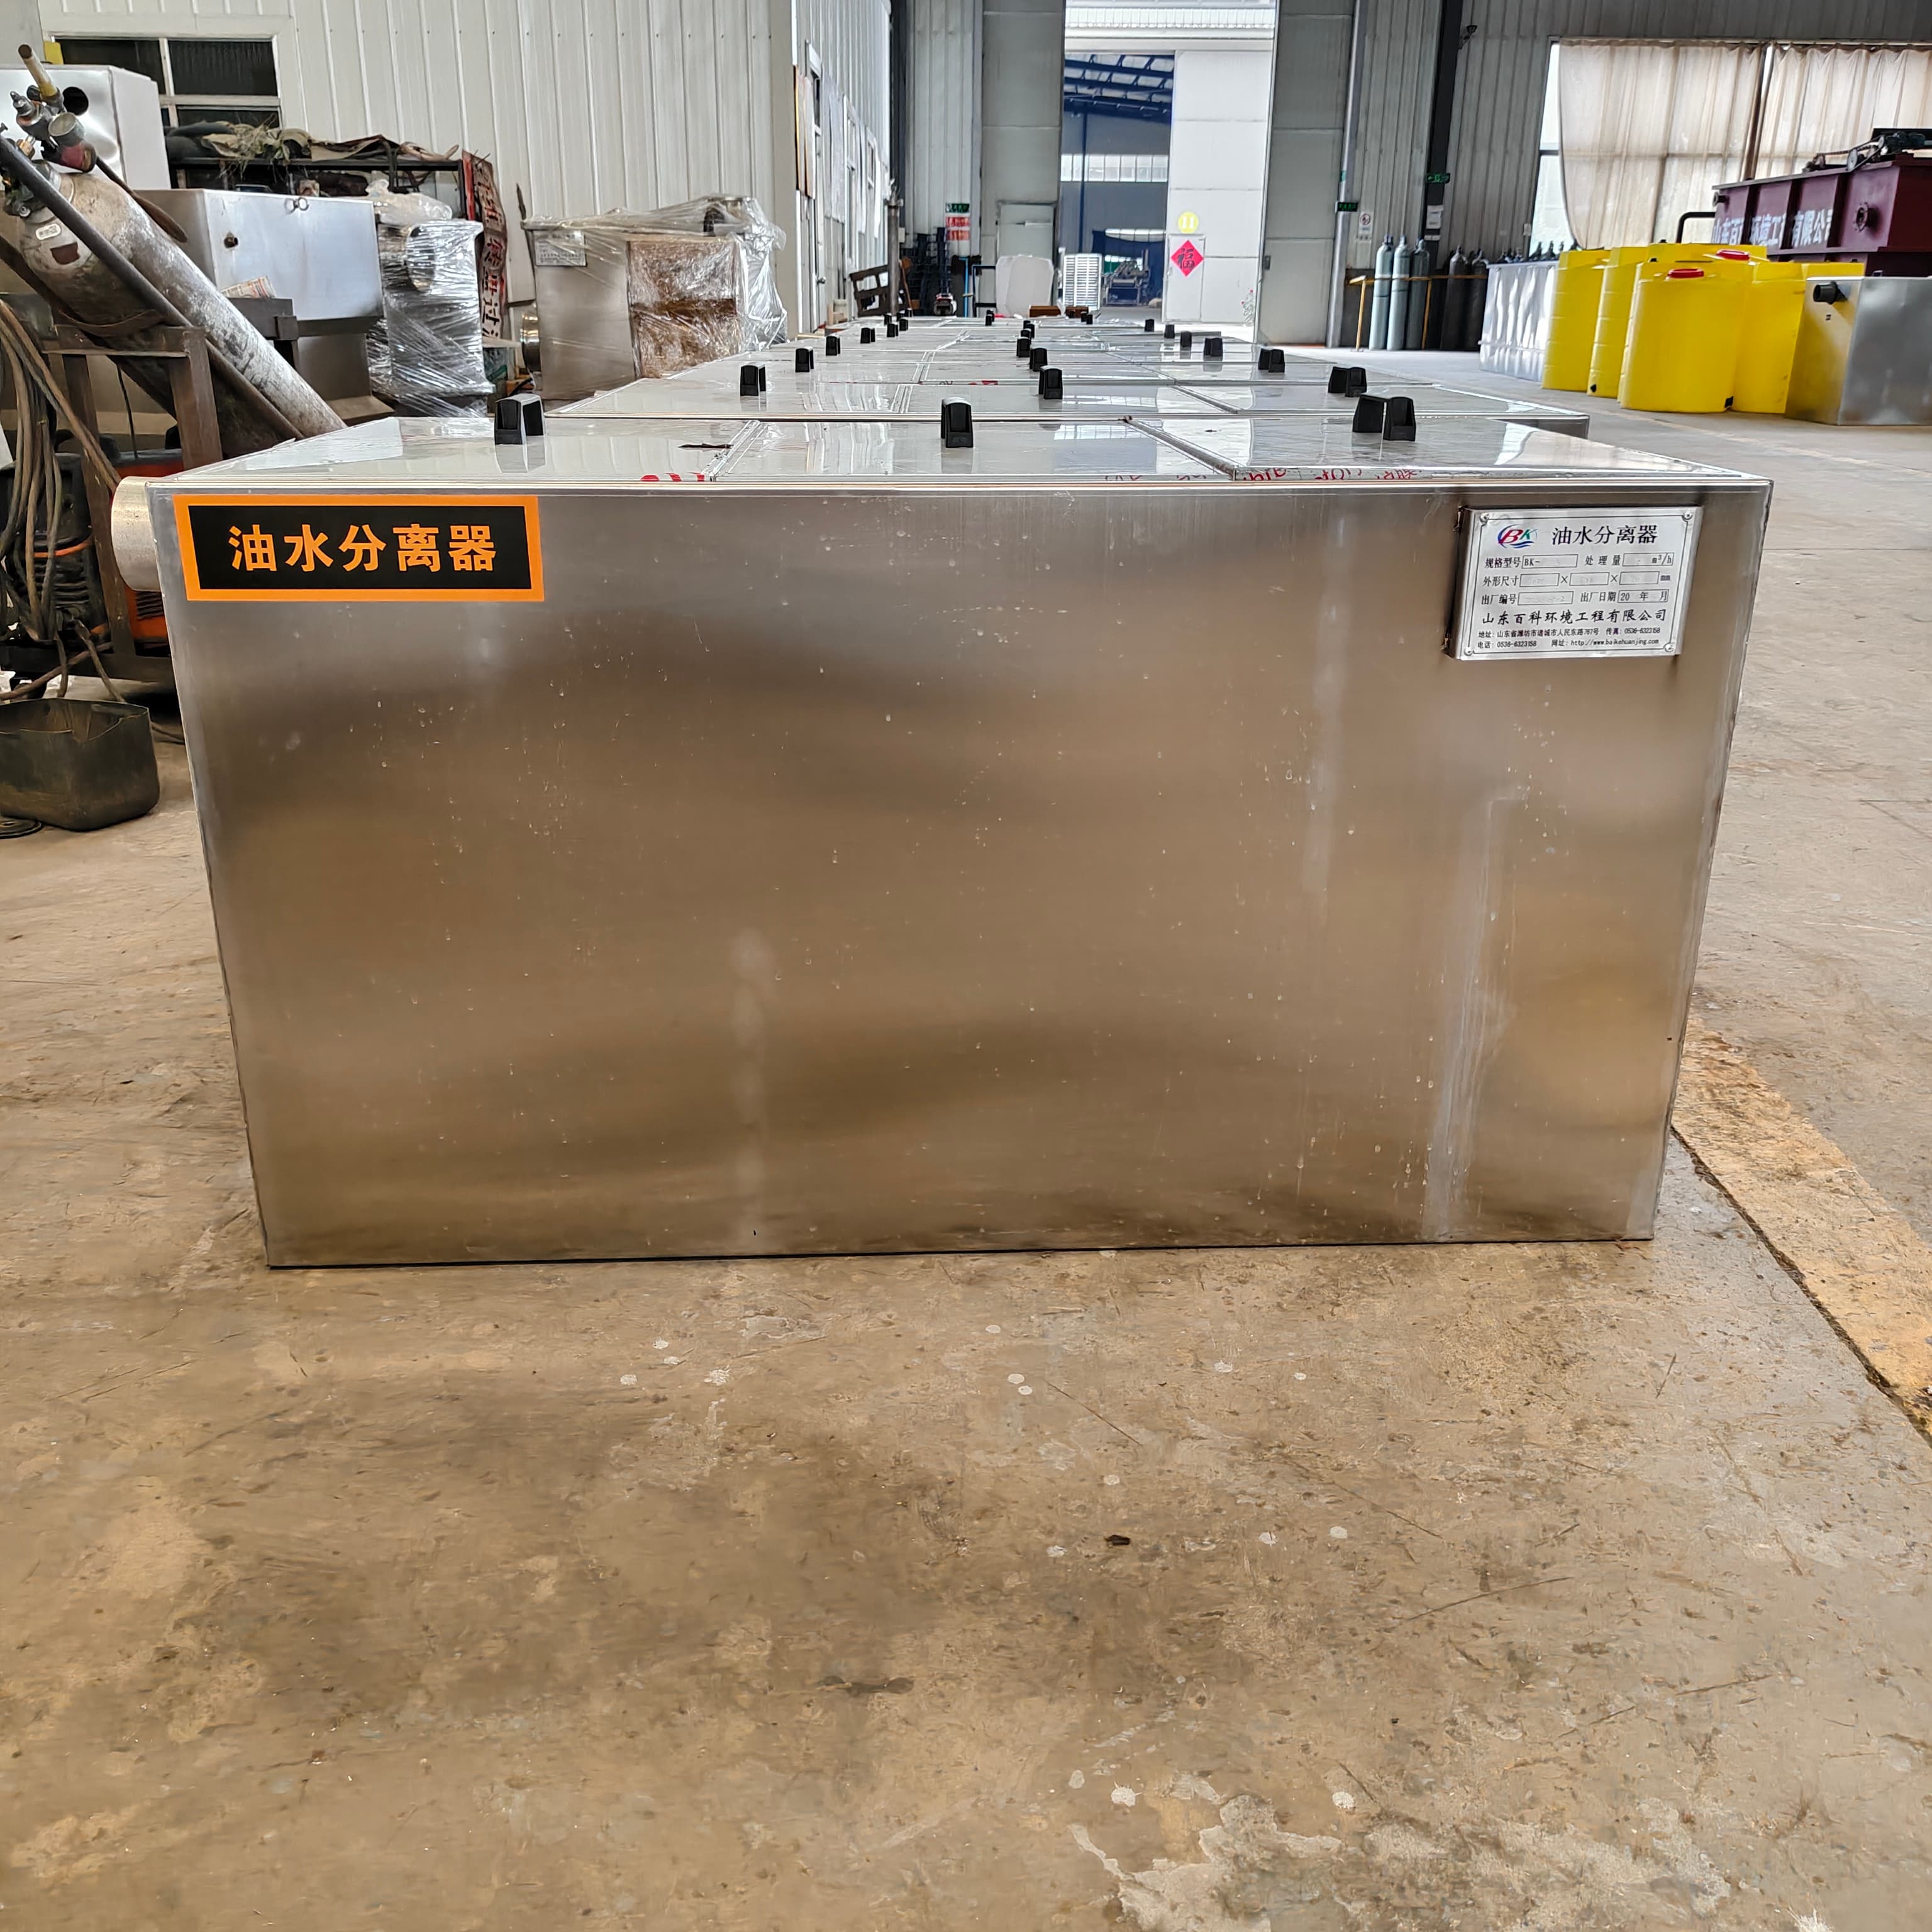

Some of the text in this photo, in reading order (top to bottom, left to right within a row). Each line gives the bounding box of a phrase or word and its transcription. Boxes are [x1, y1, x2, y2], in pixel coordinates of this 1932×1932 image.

[1182, 216, 1194, 229] 11
[1177, 248, 1195, 270] 福
[1498, 529, 1538, 544] BK
[1552, 525, 1658, 545] 油水分离器
[228, 523, 496, 572] 油水分离器
[1484, 557, 1521, 569] 规格型号
[1585, 555, 1621, 566] 处理量
[1483, 575, 1519, 587] 外形尺寸
[1481, 594, 1517, 605] 出厂编号
[1580, 591, 1667, 602] 出厂日期 20 年 月
[1482, 609, 1667, 625] 山东百科环境工程有限公司
